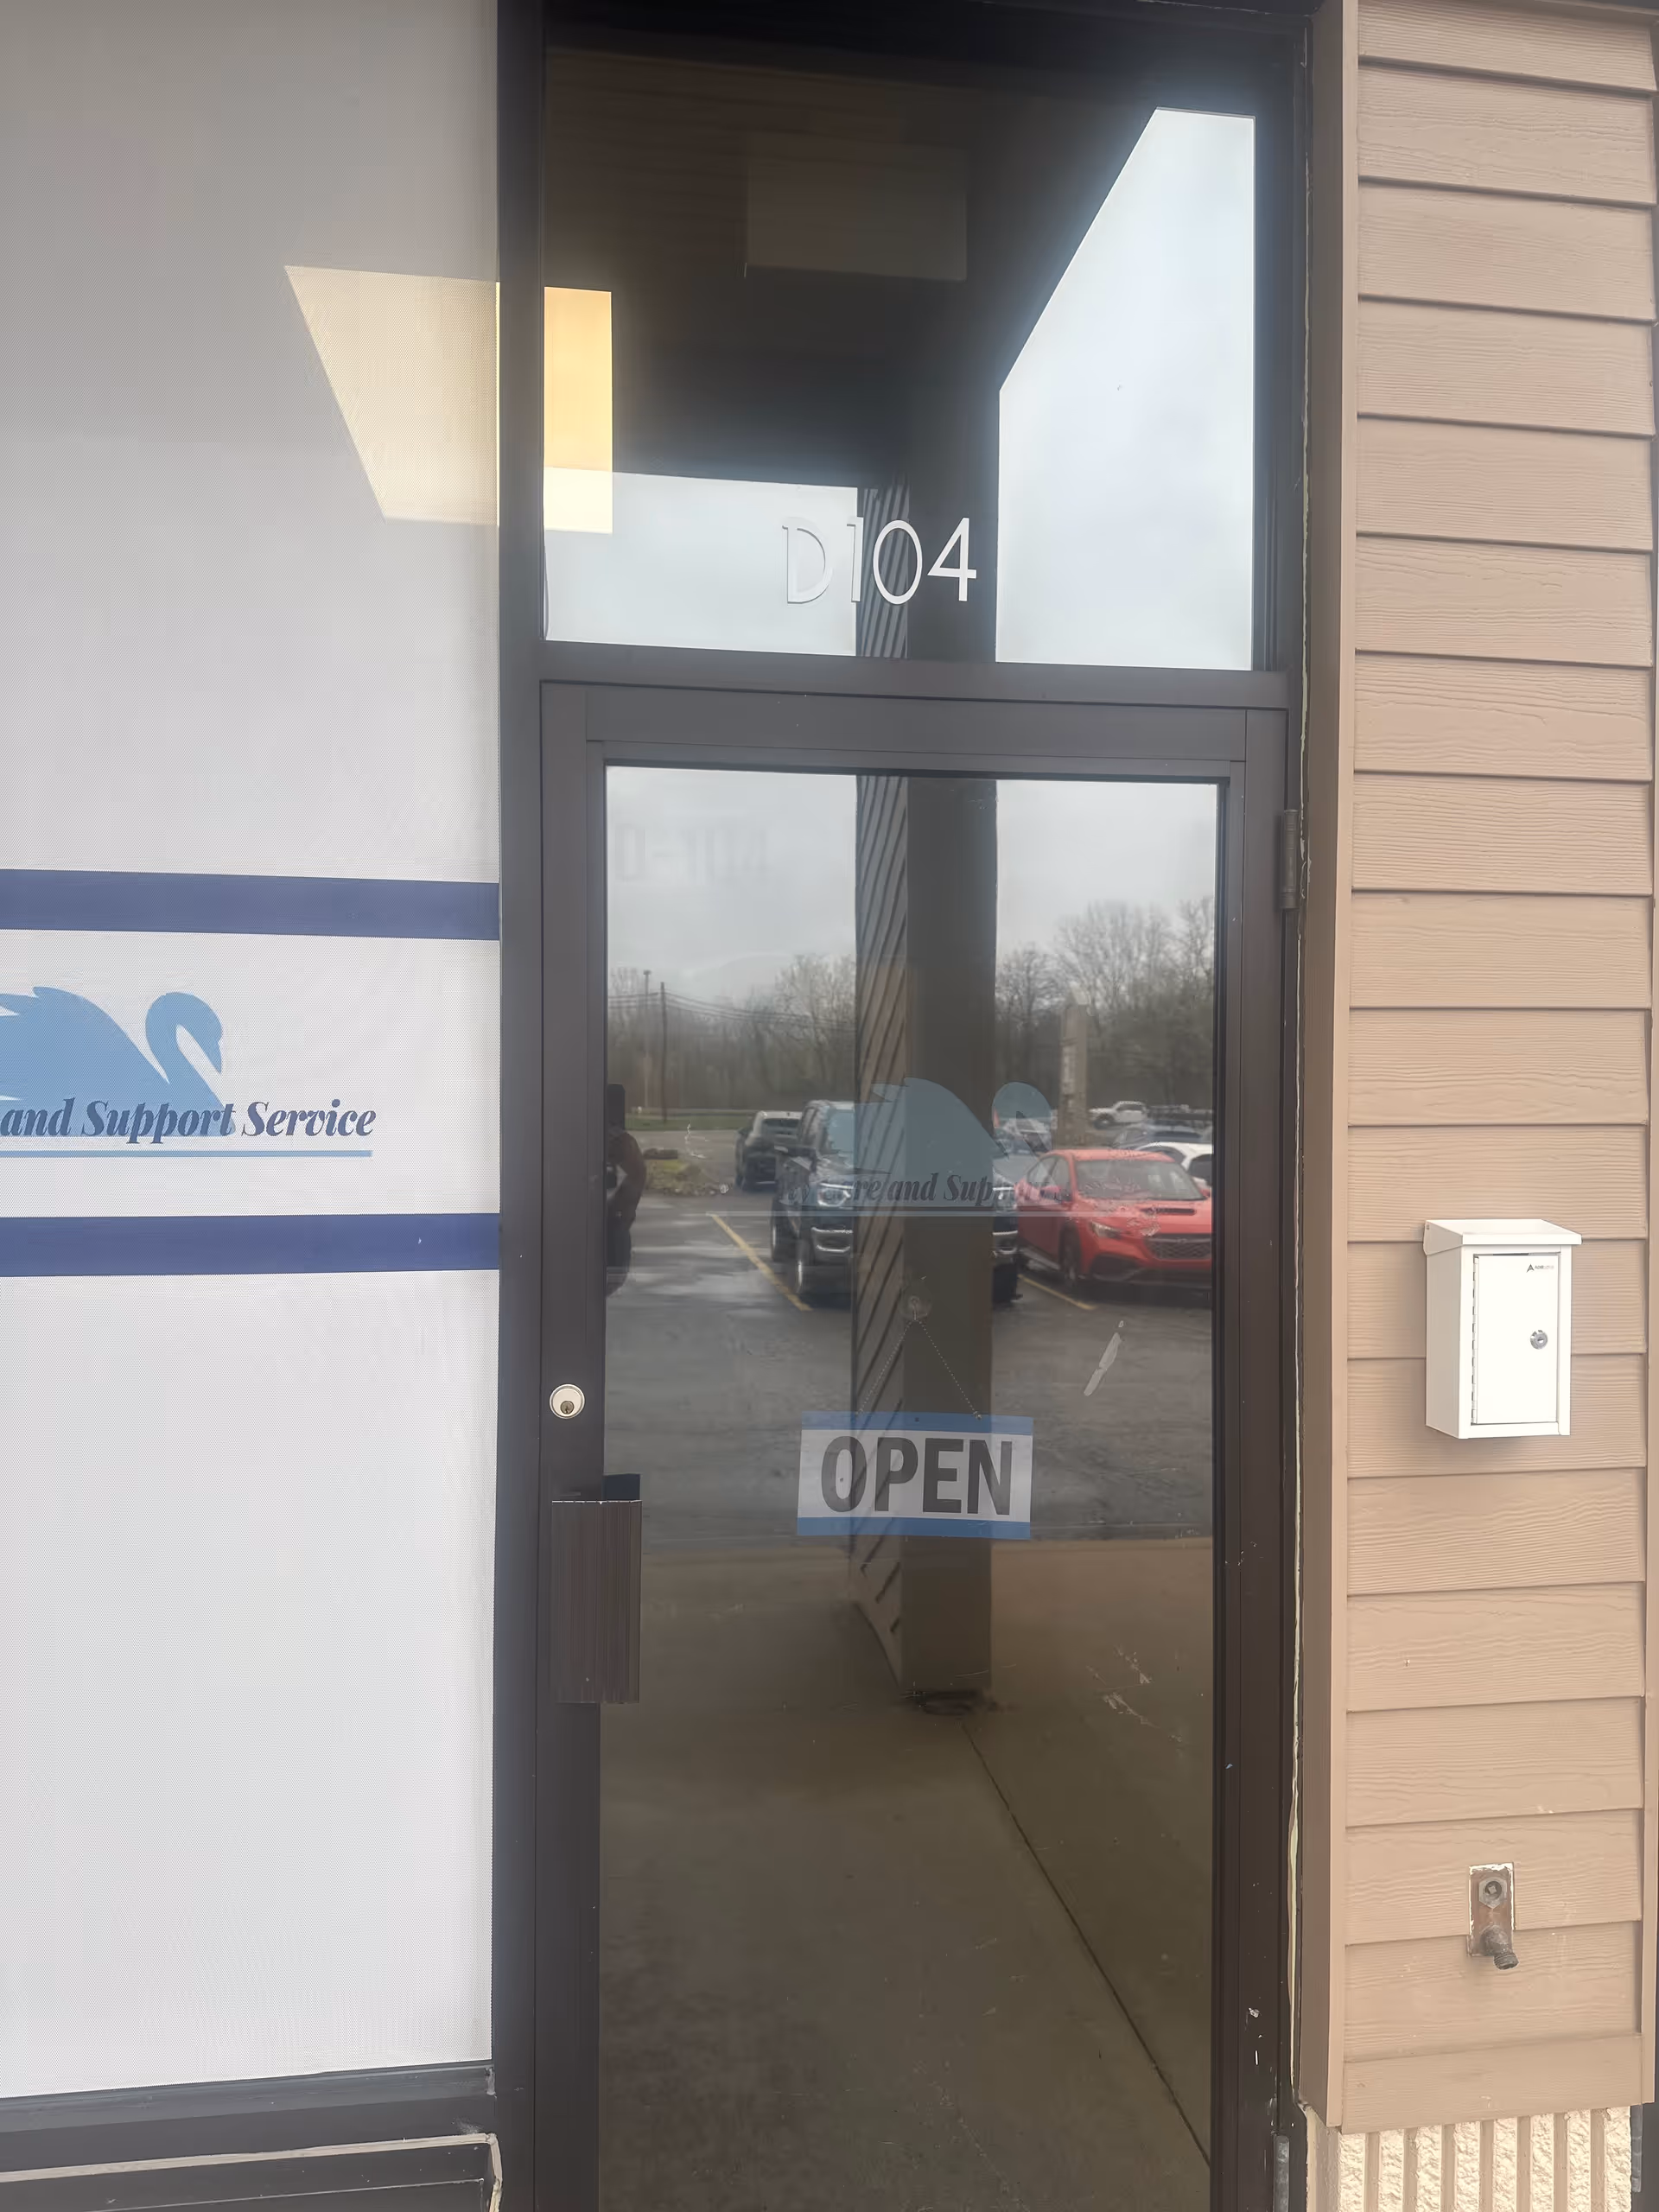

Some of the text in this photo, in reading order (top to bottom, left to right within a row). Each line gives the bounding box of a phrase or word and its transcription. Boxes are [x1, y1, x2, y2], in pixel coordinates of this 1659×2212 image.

[782, 515, 977, 605] D104
[0, 1097, 377, 1144] and Support Service
[887, 1172, 939, 1201] and
[821, 1435, 1013, 1516] OPEN
